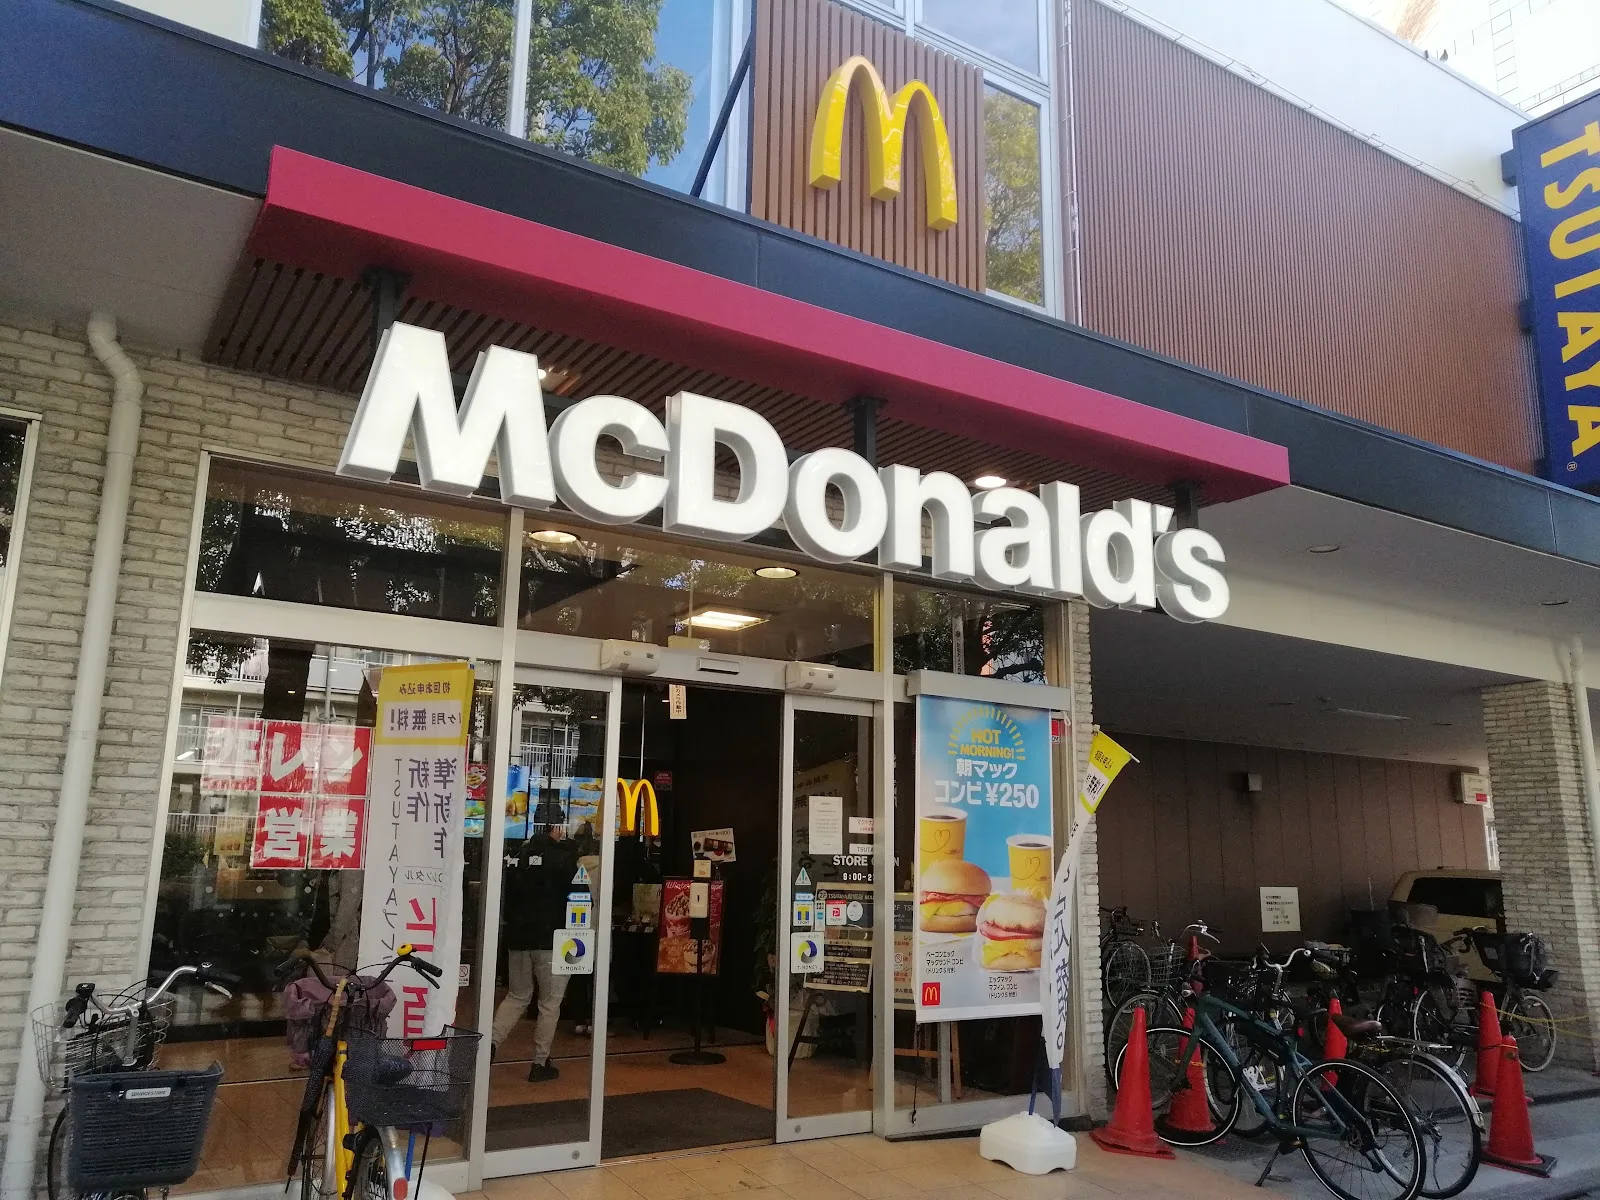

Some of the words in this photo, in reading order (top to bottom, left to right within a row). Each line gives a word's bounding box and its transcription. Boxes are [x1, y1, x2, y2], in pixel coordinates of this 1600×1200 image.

[336, 321, 1228, 623] McDonald's
[971, 729, 1002, 745] HOT
[960, 744, 1015, 759] MORNING!
[956, 758, 1018, 779] 朝マック
[935, 780, 982, 805] コンビ
[985, 782, 1040, 809] ¥250
[263, 807, 359, 859] 営業
[833, 855, 868, 866] STORE
